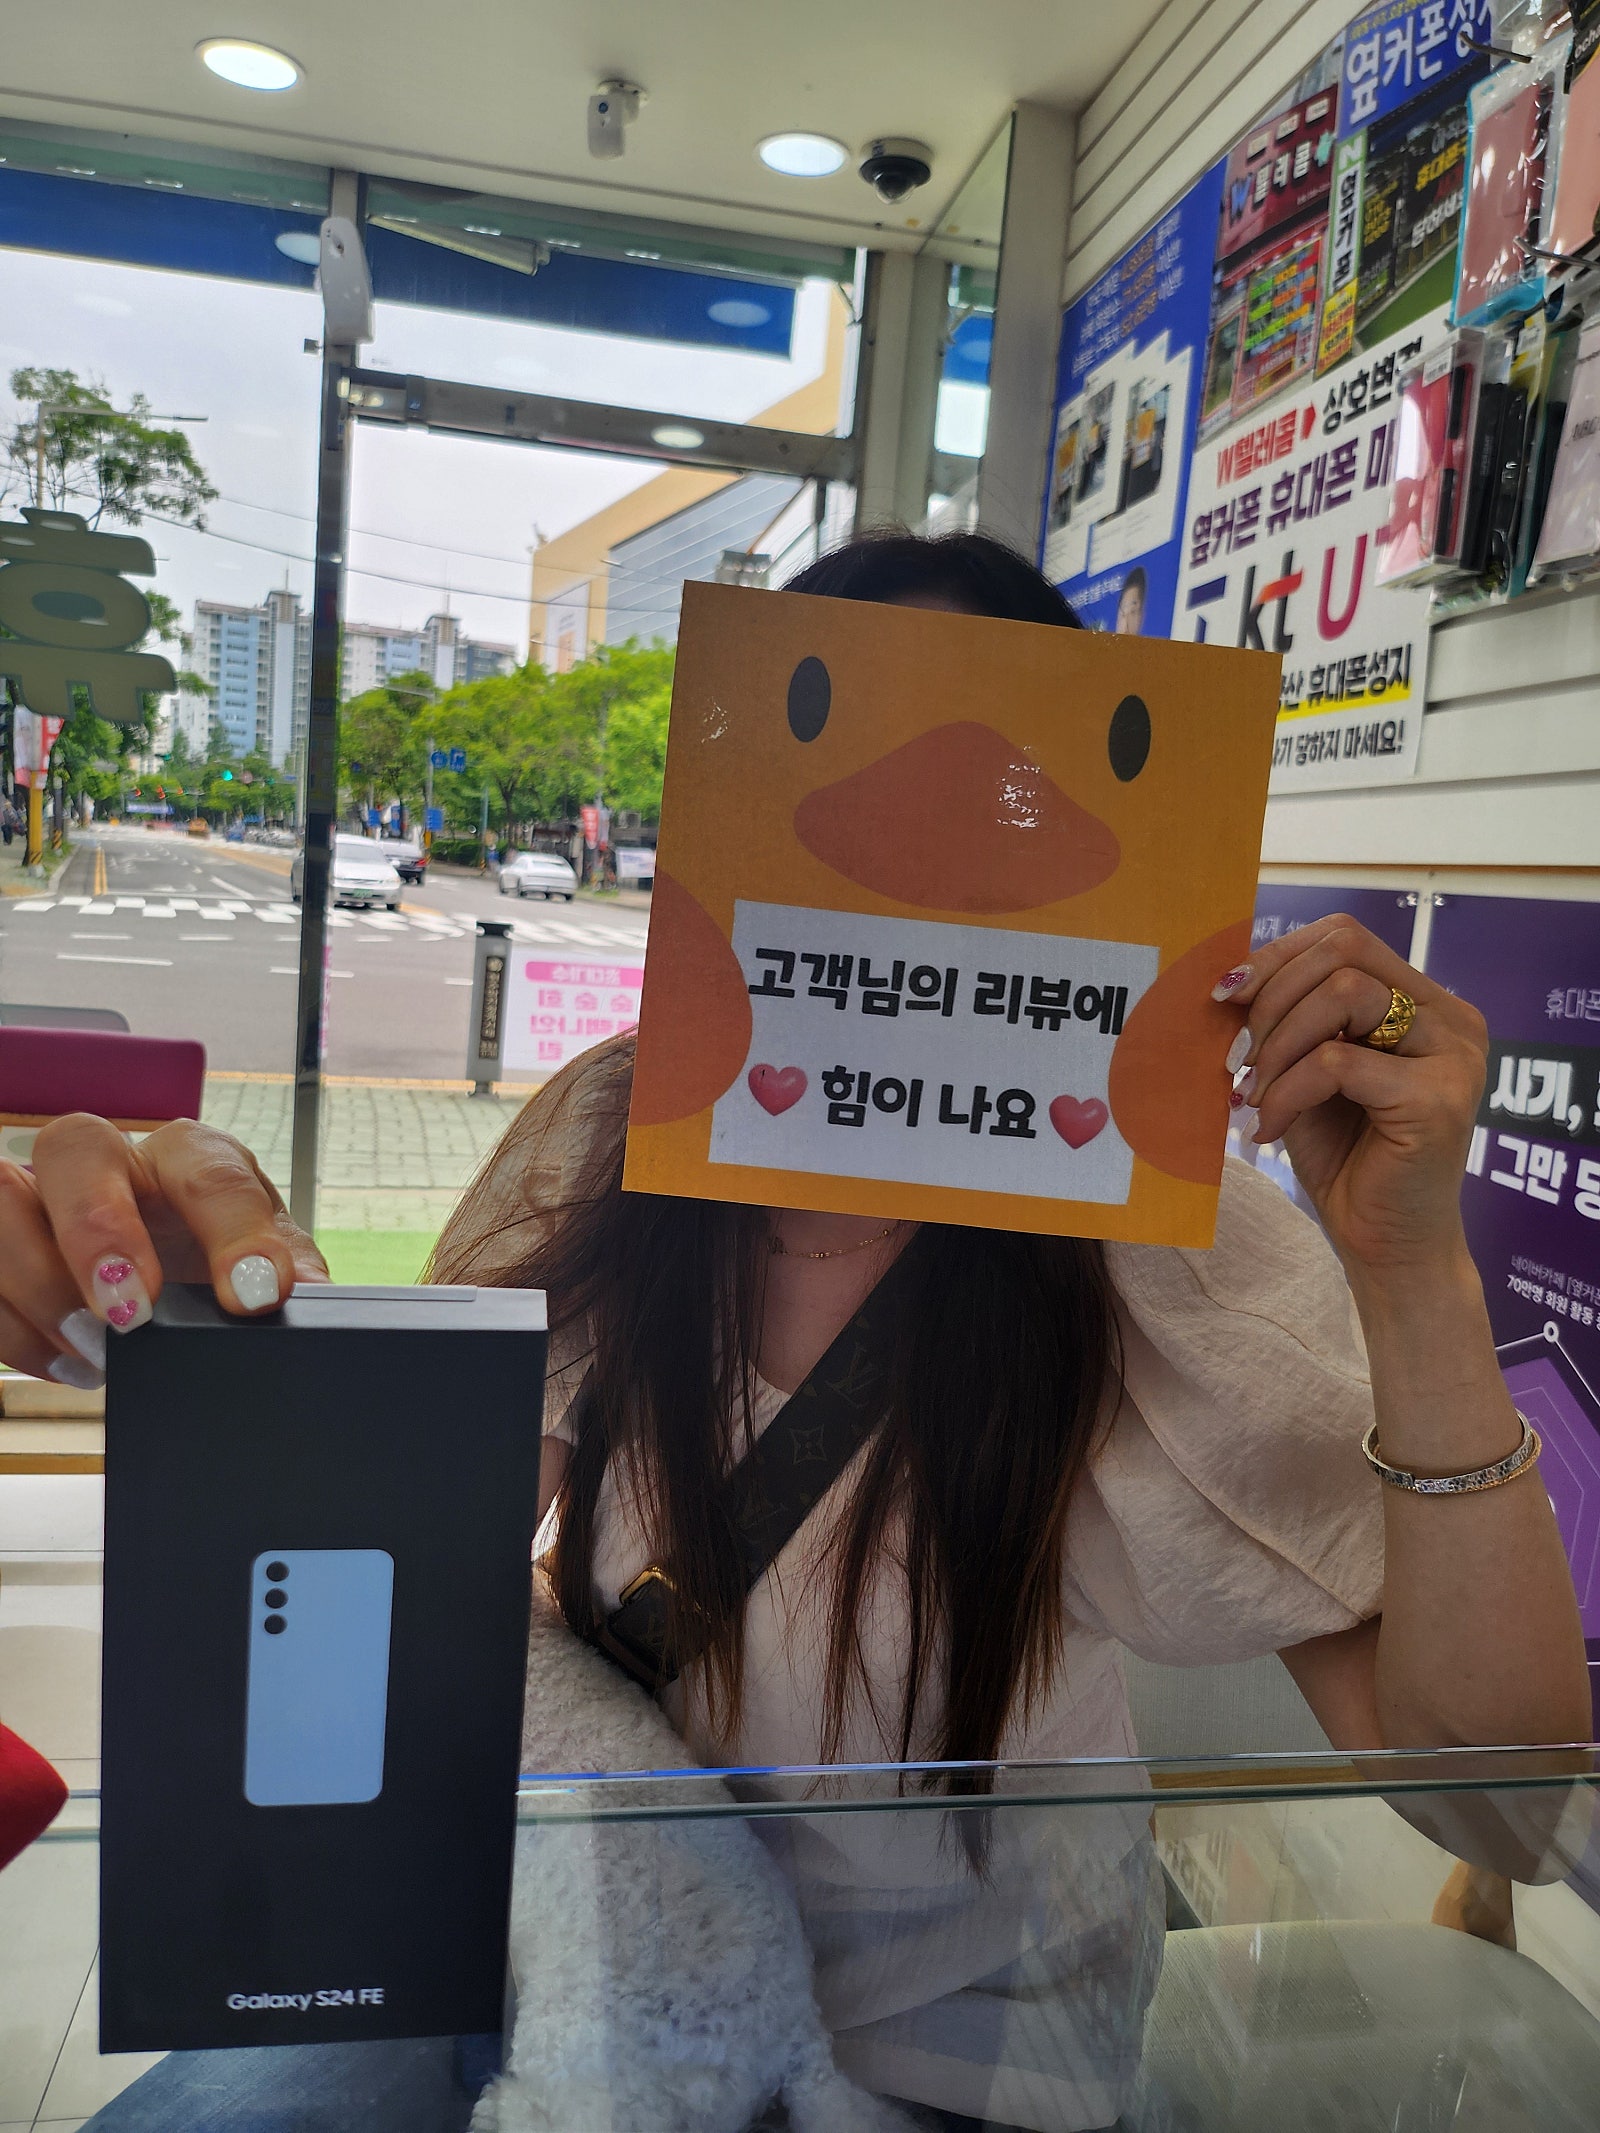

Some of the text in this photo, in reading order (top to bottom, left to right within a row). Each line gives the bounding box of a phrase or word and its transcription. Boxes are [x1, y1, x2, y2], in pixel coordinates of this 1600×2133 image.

[1189, 486, 1263, 570] 옆커폰
[1265, 436, 1359, 537] 휴대폰
[1236, 549, 1305, 655] kt
[1279, 642, 1412, 712] 산 휴대폰성지
[1273, 718, 1405, 769] 기 당하지 마세요!
[748, 947, 1129, 1035] 고객님의 리뷰에
[822, 1065, 1037, 1140] 힘이 나요
[1489, 1055, 1583, 1132] 사기,
[1489, 1134, 1568, 1206] 그만
[1507, 1273, 1544, 1305] 70만명
[1545, 1290, 1569, 1316] 회원
[1569, 1300, 1595, 1327] 활동
[226, 1987, 385, 2012] Galaxy S24 FE
